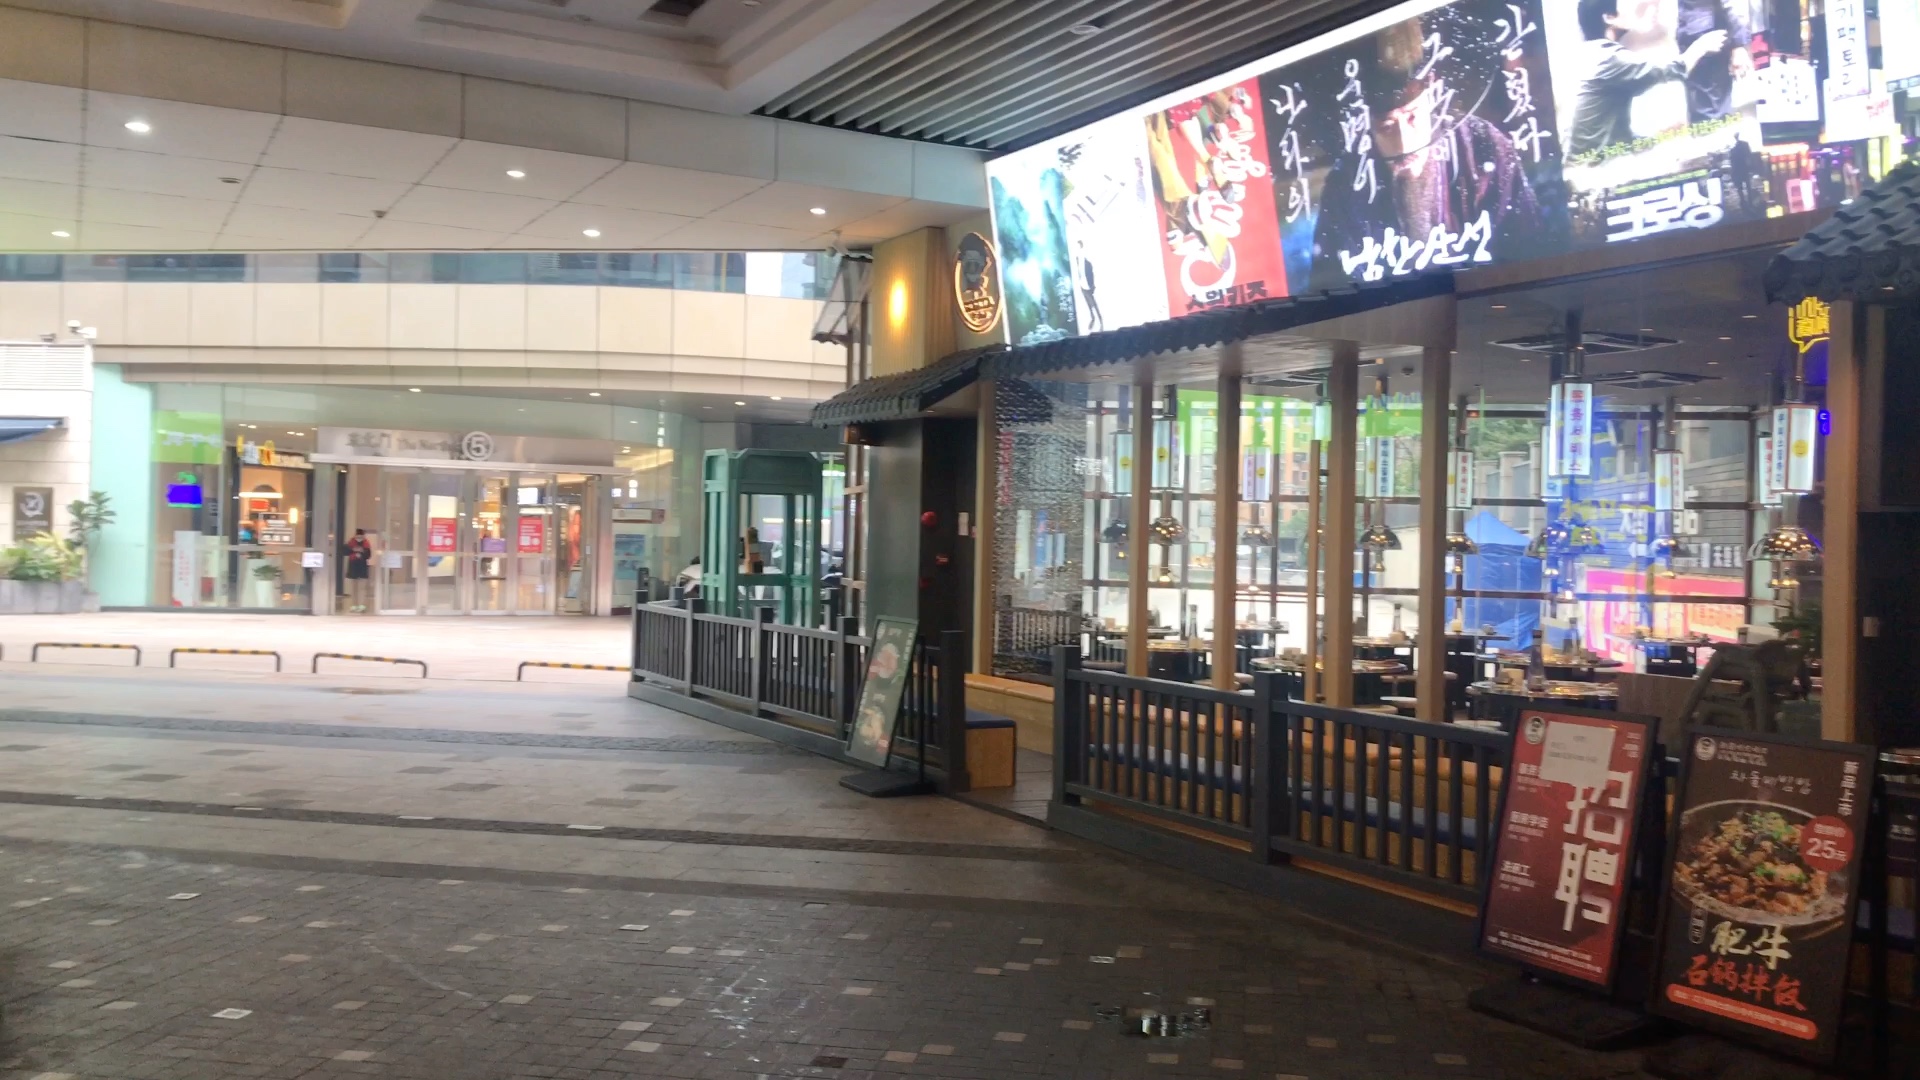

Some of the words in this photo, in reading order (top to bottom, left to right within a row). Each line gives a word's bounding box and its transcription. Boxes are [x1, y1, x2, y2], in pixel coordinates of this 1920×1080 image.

[1837, 760, 1860, 817] 新品上市
[1554, 770, 1633, 932] 招聘
[1710, 920, 1793, 970] 肥牛
[1682, 954, 1808, 1012] 石锅拌饭
